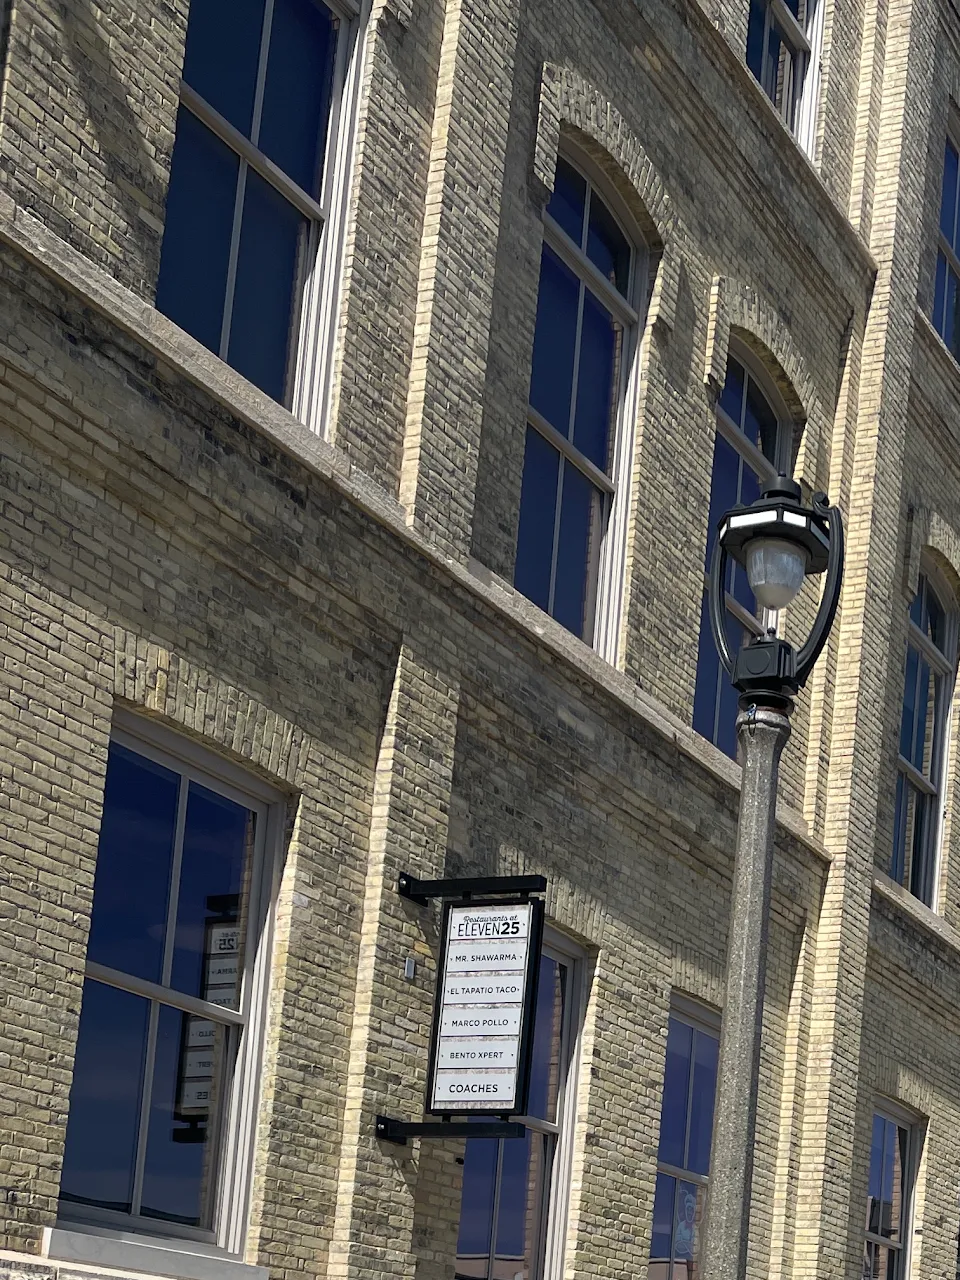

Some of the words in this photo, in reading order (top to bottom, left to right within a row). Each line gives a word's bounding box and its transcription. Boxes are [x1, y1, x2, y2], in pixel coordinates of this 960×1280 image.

[463, 915, 508, 924] Restaurants
[457, 921, 520, 937] ELEVEN25
[455, 954, 469, 962] MR.
[471, 953, 517, 962] SHAWARMA
[450, 987, 459, 995] EL
[461, 986, 494, 994] TAPATIO
[496, 985, 517, 993] TACO
[451, 1019, 480, 1027] MARCO
[482, 1018, 509, 1026] POLLO
[478, 1051, 504, 1059] XPERT
[448, 1084, 499, 1093] COACHES
